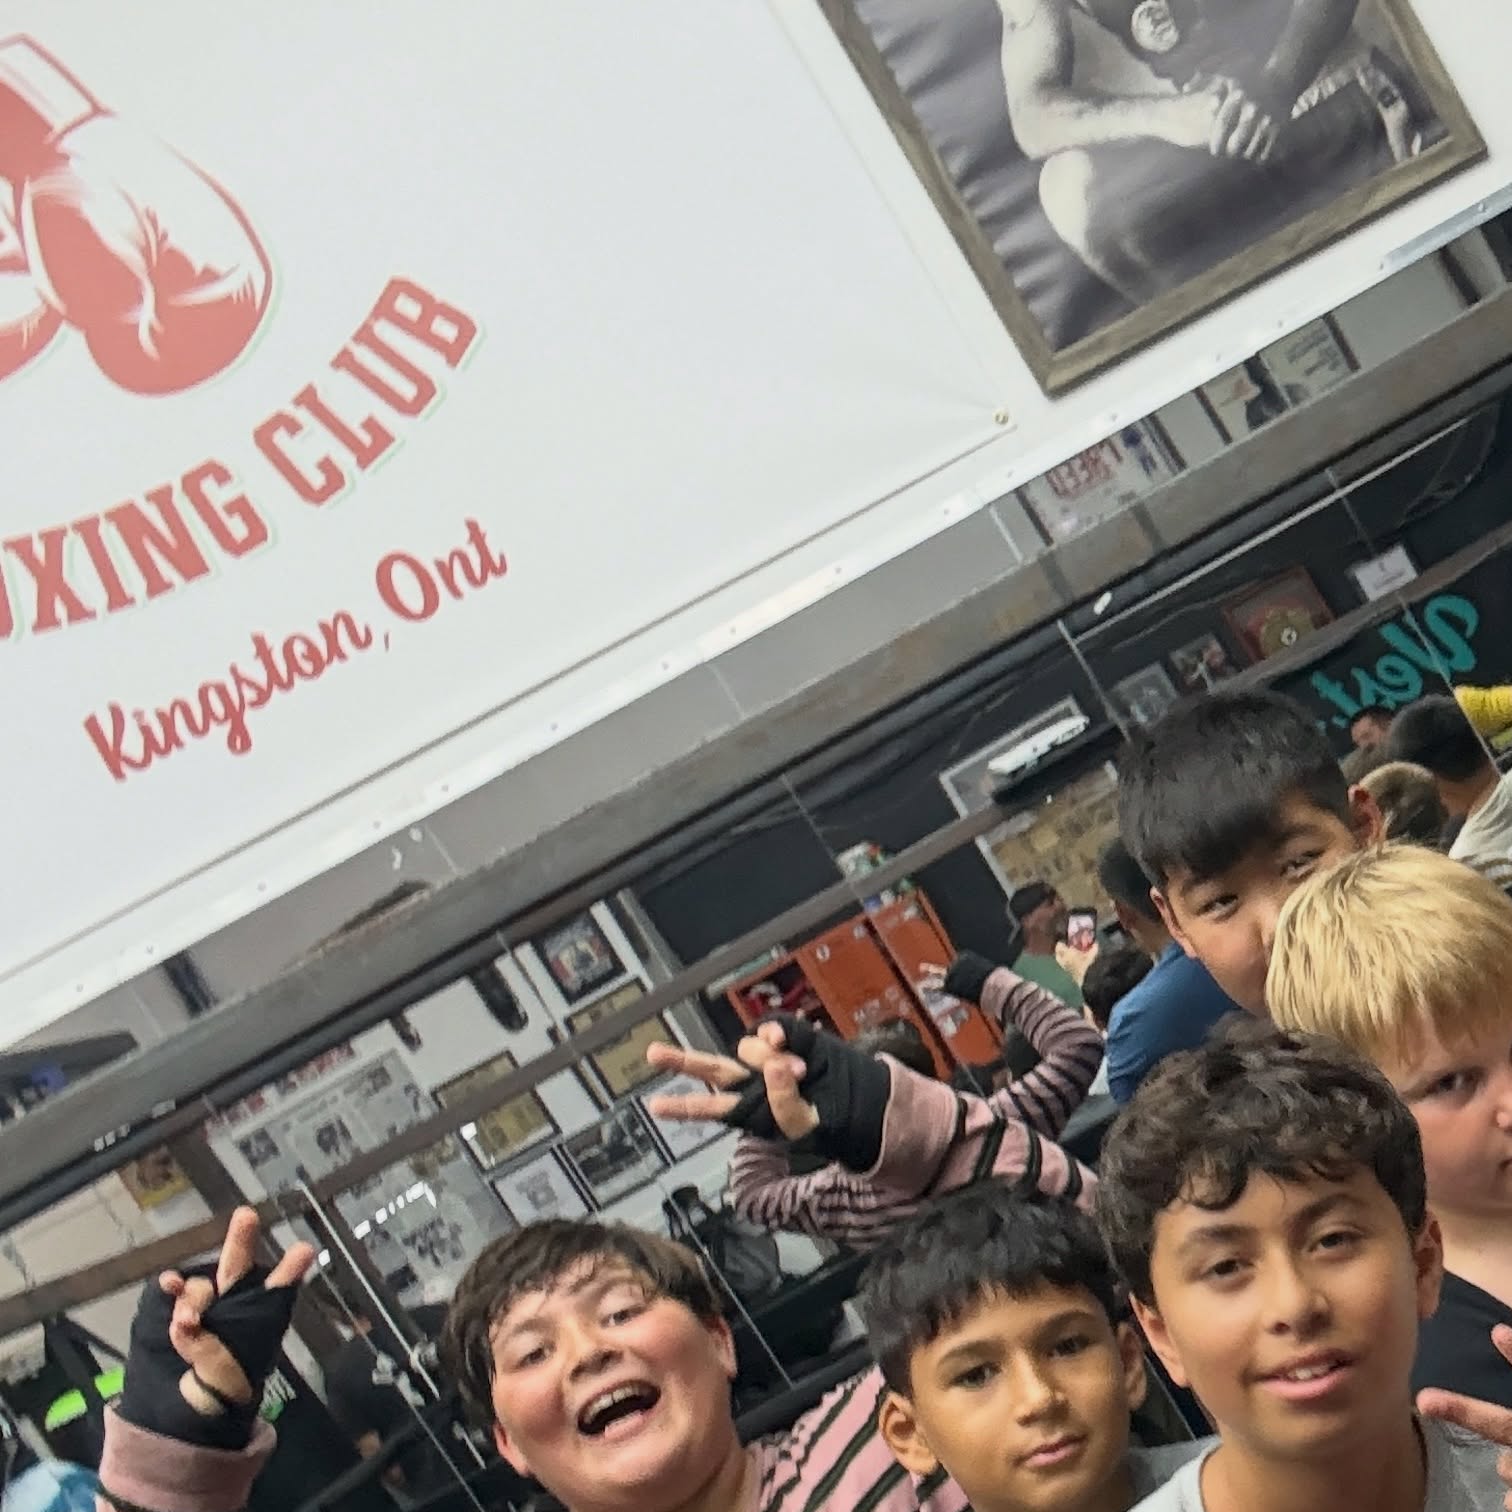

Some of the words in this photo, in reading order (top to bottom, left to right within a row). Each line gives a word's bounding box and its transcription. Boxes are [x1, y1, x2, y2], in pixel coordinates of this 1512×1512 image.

[0, 461, 267, 637] XING
[254, 275, 478, 505] CLUB
[84, 611, 391, 780] Kingston,
[375, 519, 508, 622] Ont
